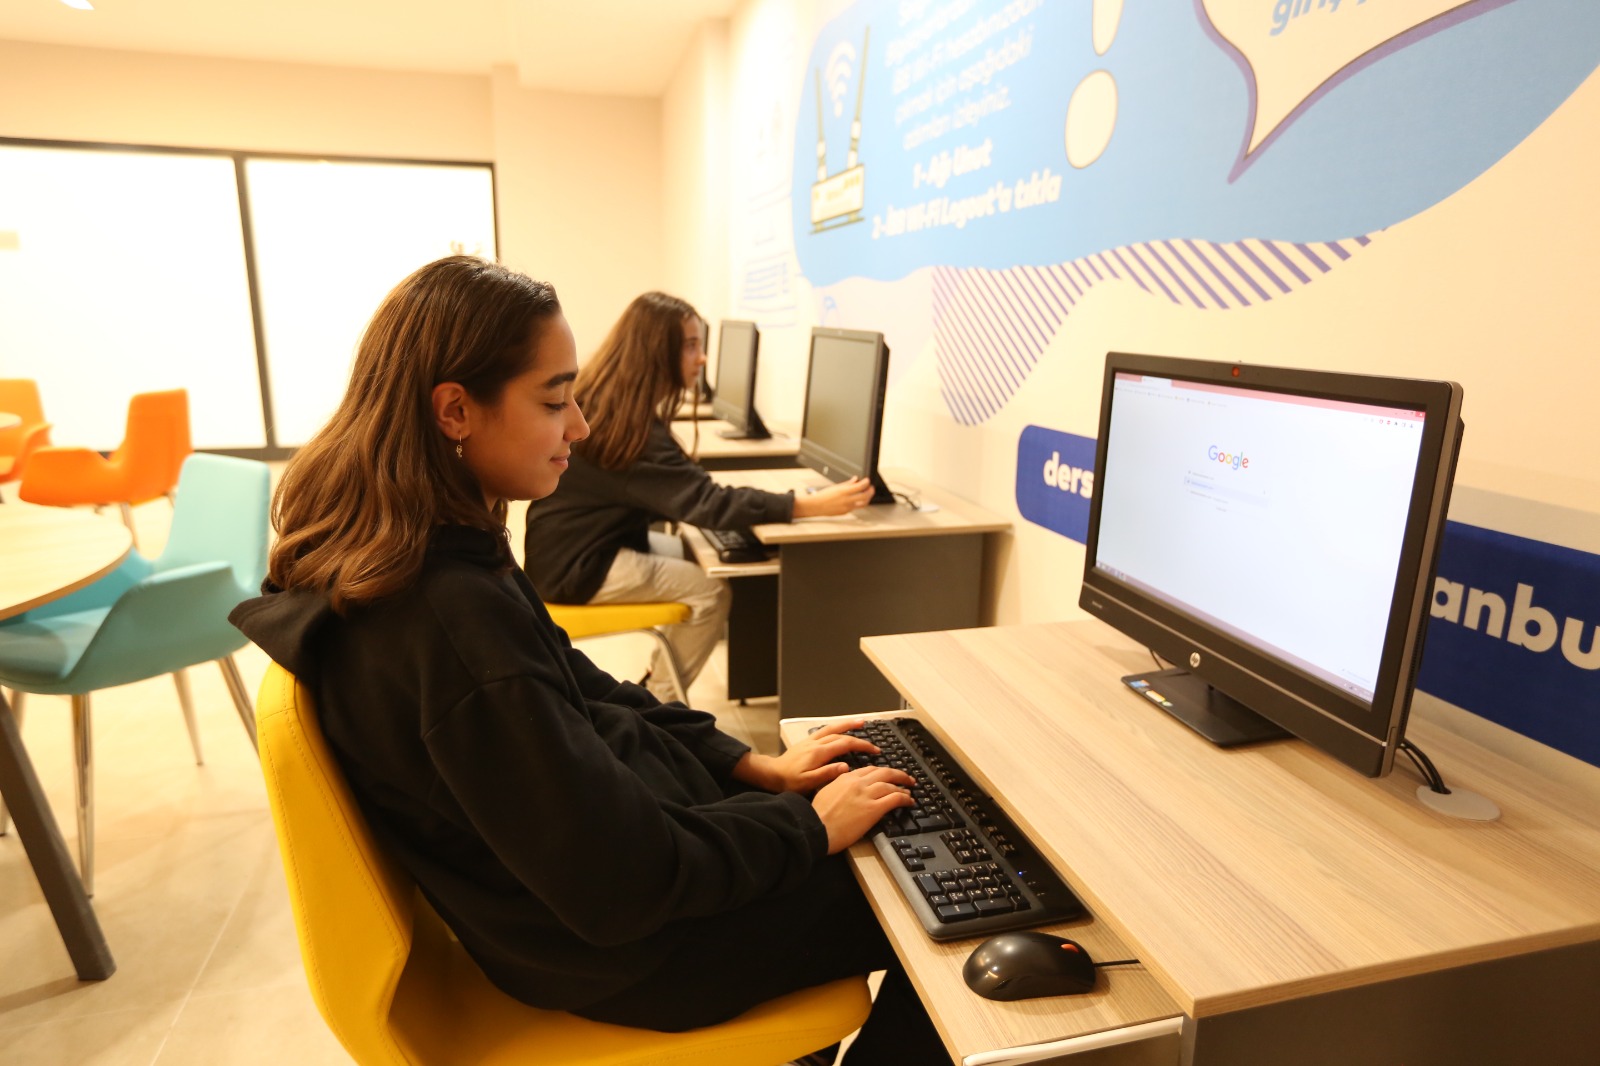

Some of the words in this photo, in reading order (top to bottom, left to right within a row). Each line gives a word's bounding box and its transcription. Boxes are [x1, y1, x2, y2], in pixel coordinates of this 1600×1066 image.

[1013, 168, 1062, 209] tıkla
[1043, 451, 1094, 499] ders
[1208, 445, 1249, 470] Google
